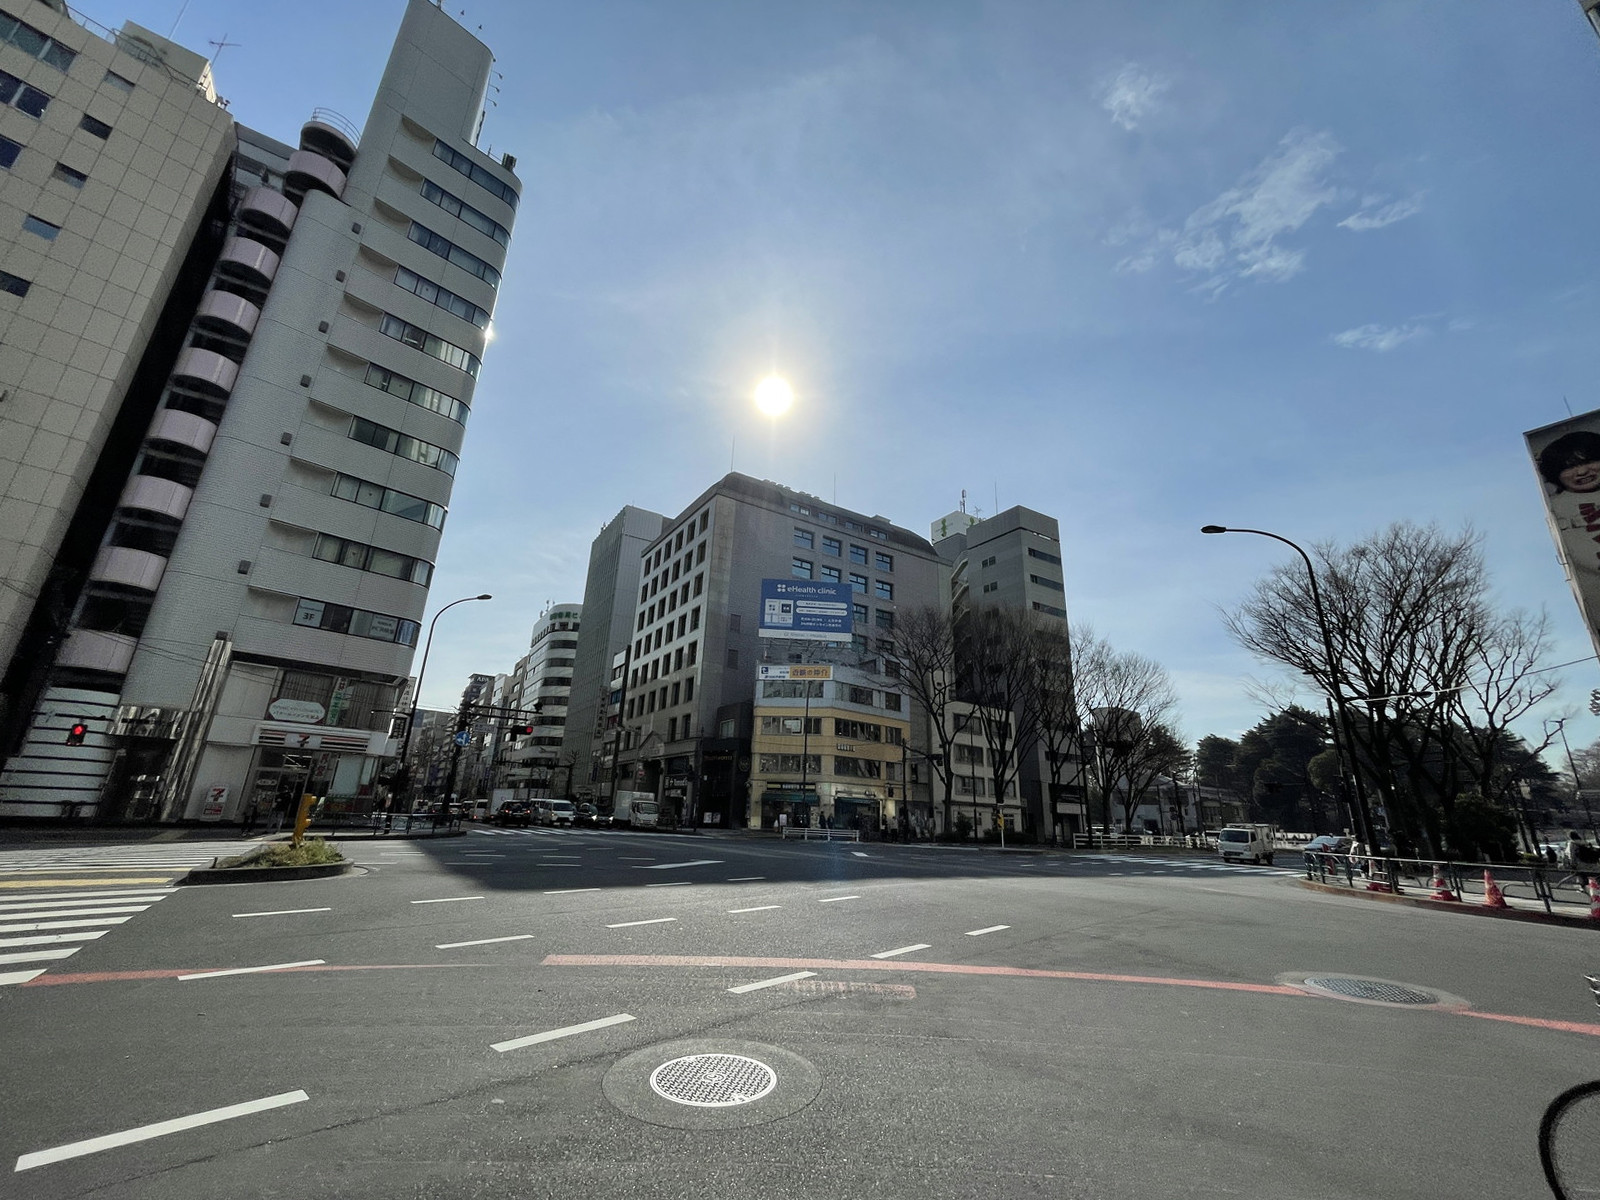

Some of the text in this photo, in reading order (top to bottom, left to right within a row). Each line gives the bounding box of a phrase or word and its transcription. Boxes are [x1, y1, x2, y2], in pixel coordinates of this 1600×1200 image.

[787, 585, 837, 595] eHealth clinic
[302, 612, 315, 621] 3F
